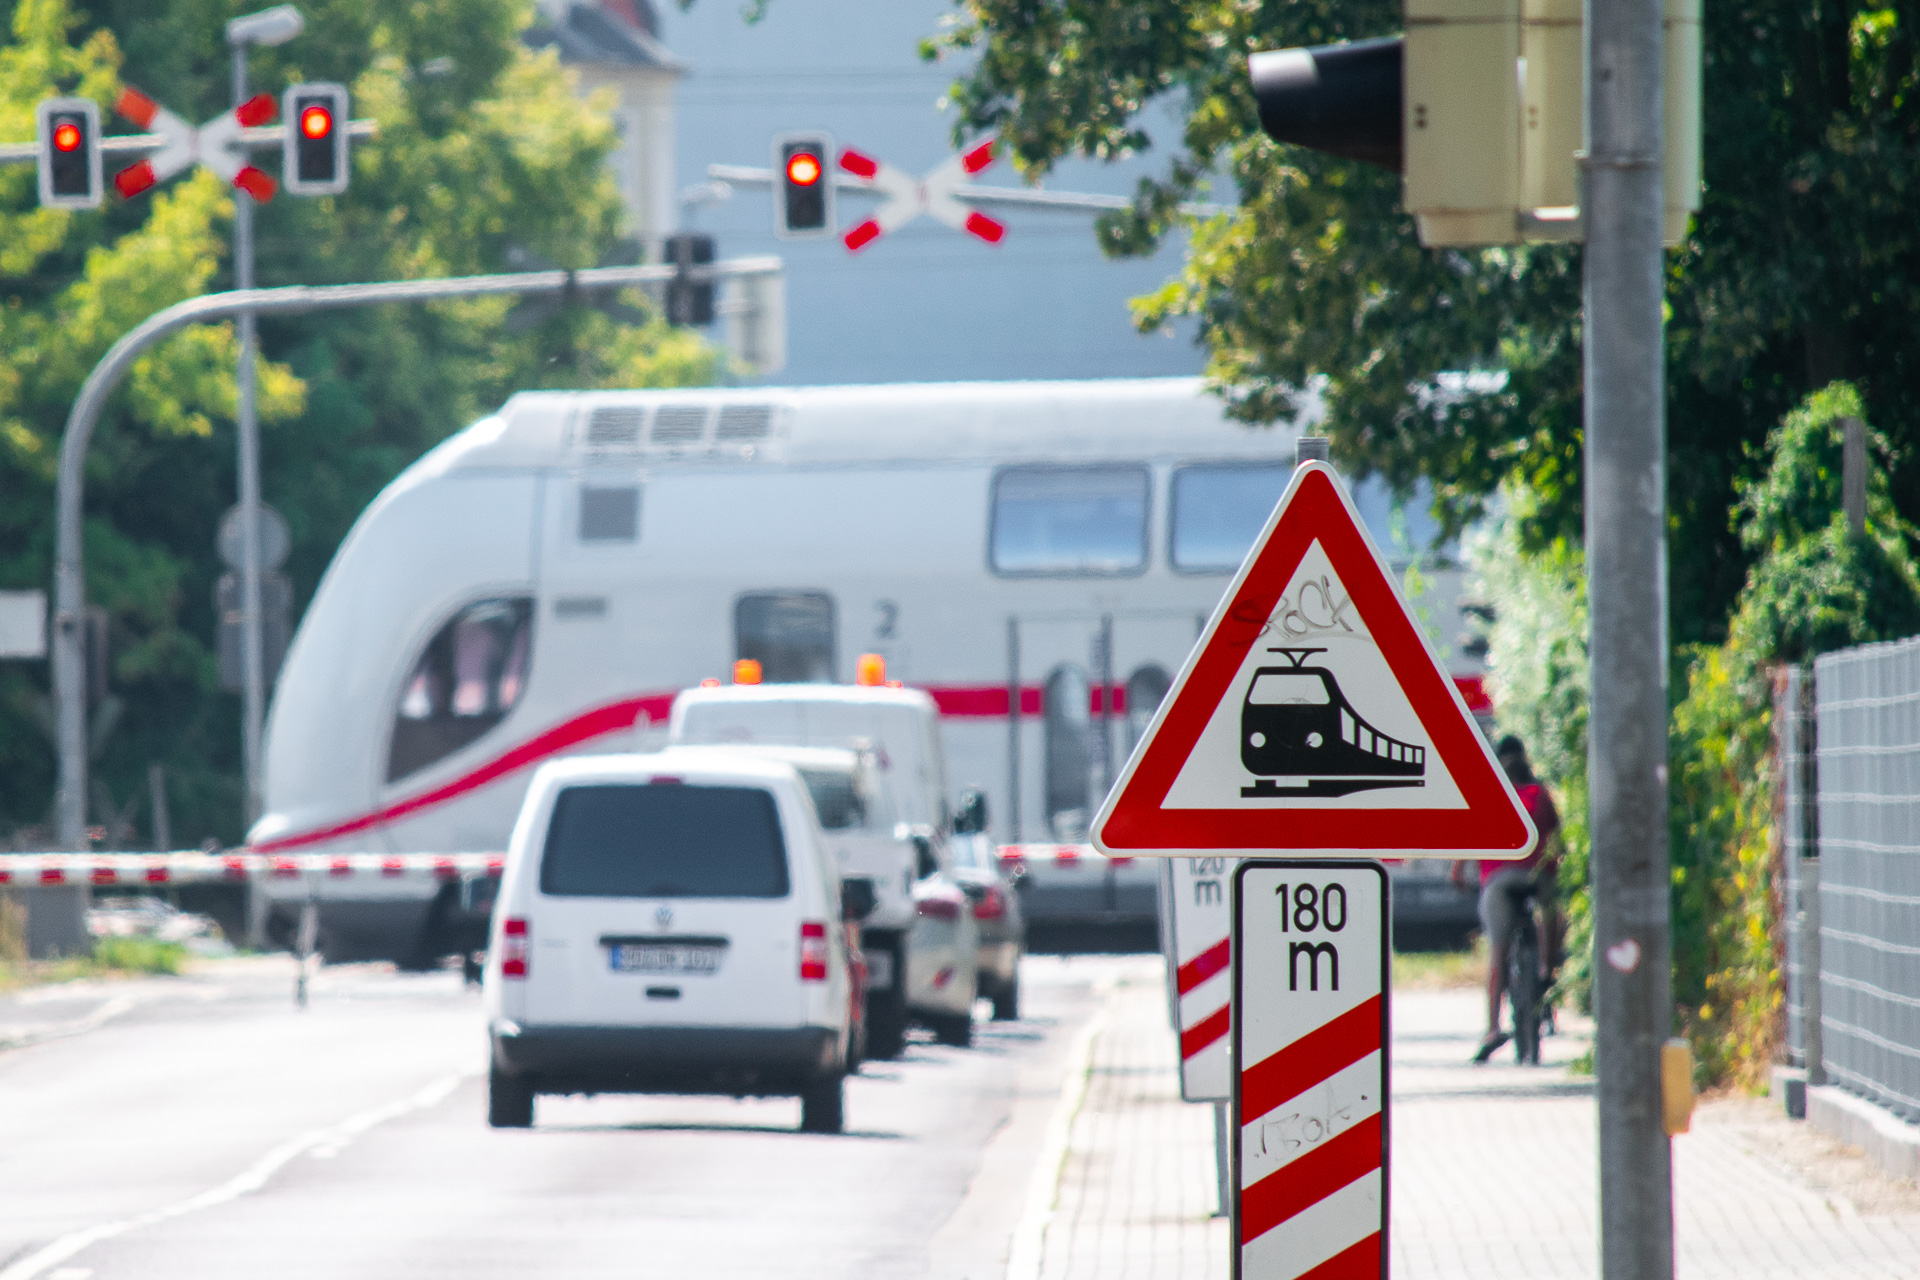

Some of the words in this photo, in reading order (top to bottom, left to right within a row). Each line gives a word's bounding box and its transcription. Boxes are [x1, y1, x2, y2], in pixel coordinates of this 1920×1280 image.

[873, 599, 900, 640] 2
[1194, 880, 1222, 905] m
[1275, 882, 1347, 932] 180
[1288, 941, 1340, 991] m
